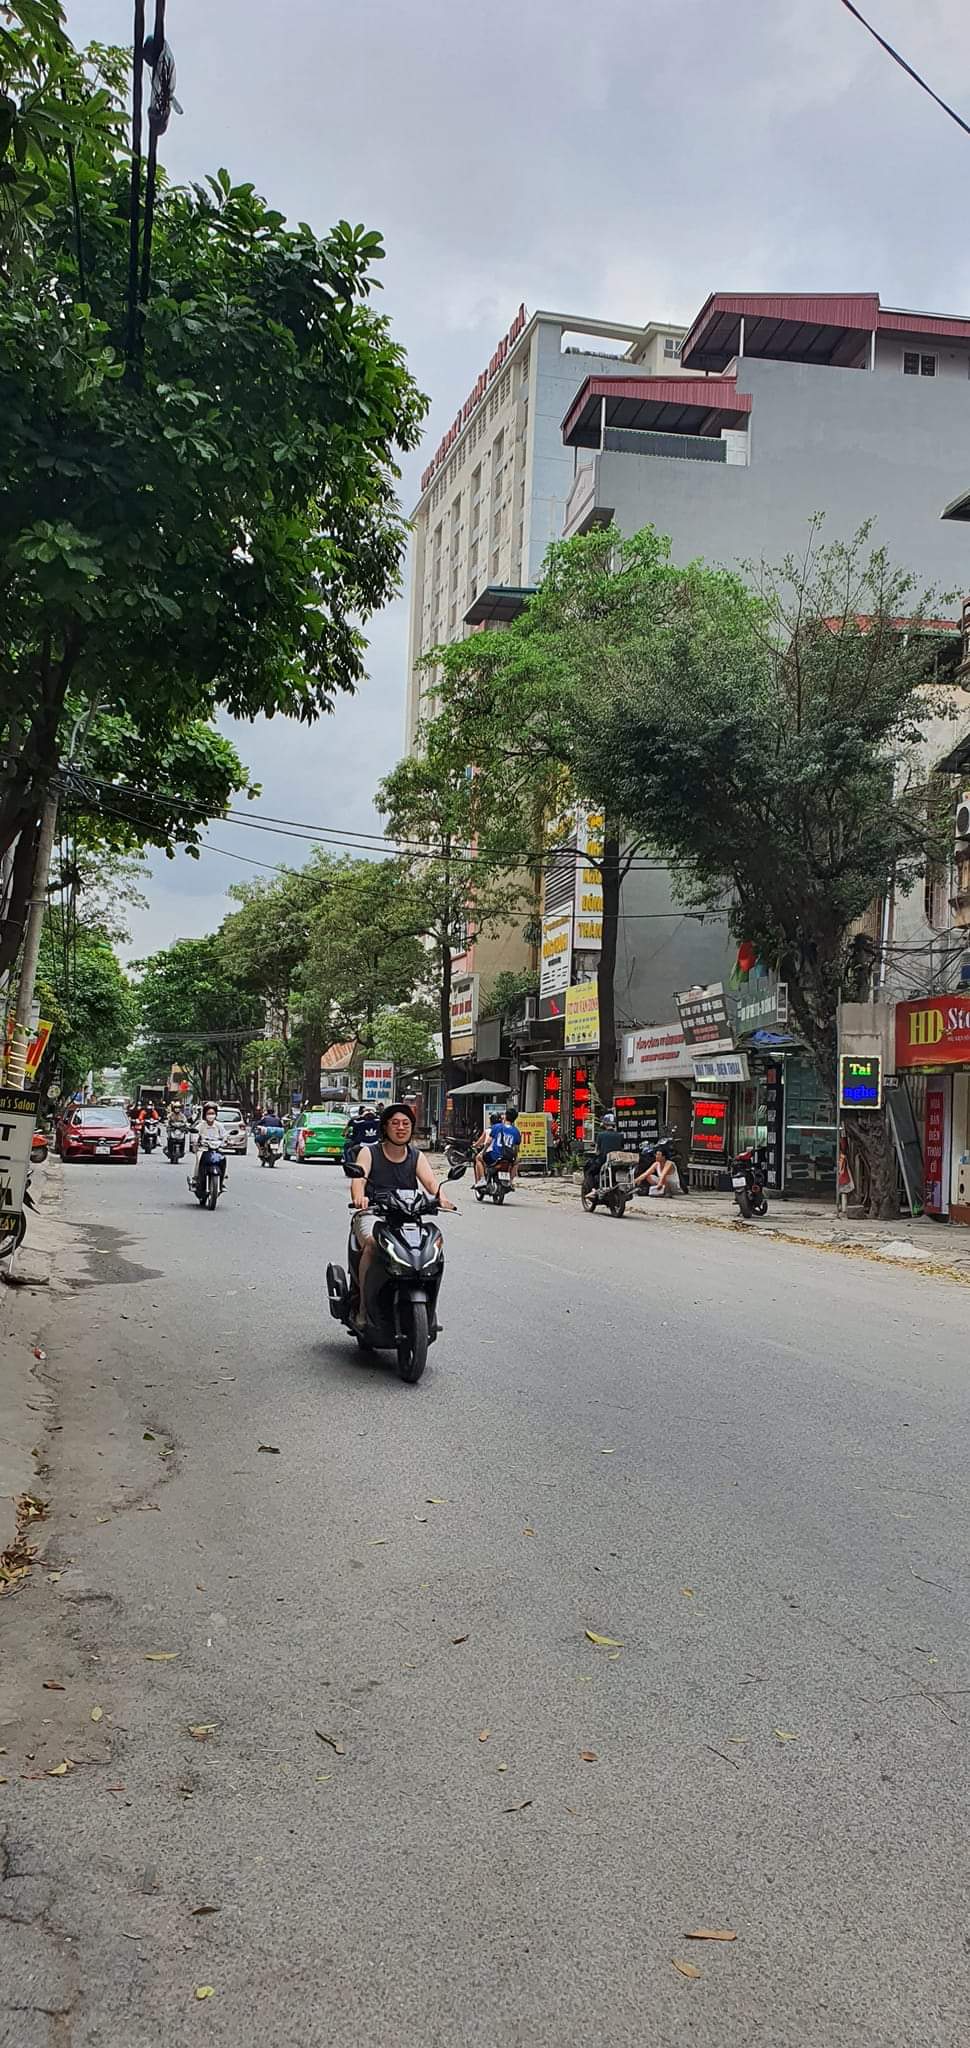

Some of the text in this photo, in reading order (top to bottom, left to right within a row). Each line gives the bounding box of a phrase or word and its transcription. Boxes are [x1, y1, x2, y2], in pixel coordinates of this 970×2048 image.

[908, 1009, 944, 1046] HD
[849, 1063, 872, 1076] Tai
[13, 1097, 36, 1112] Salon
